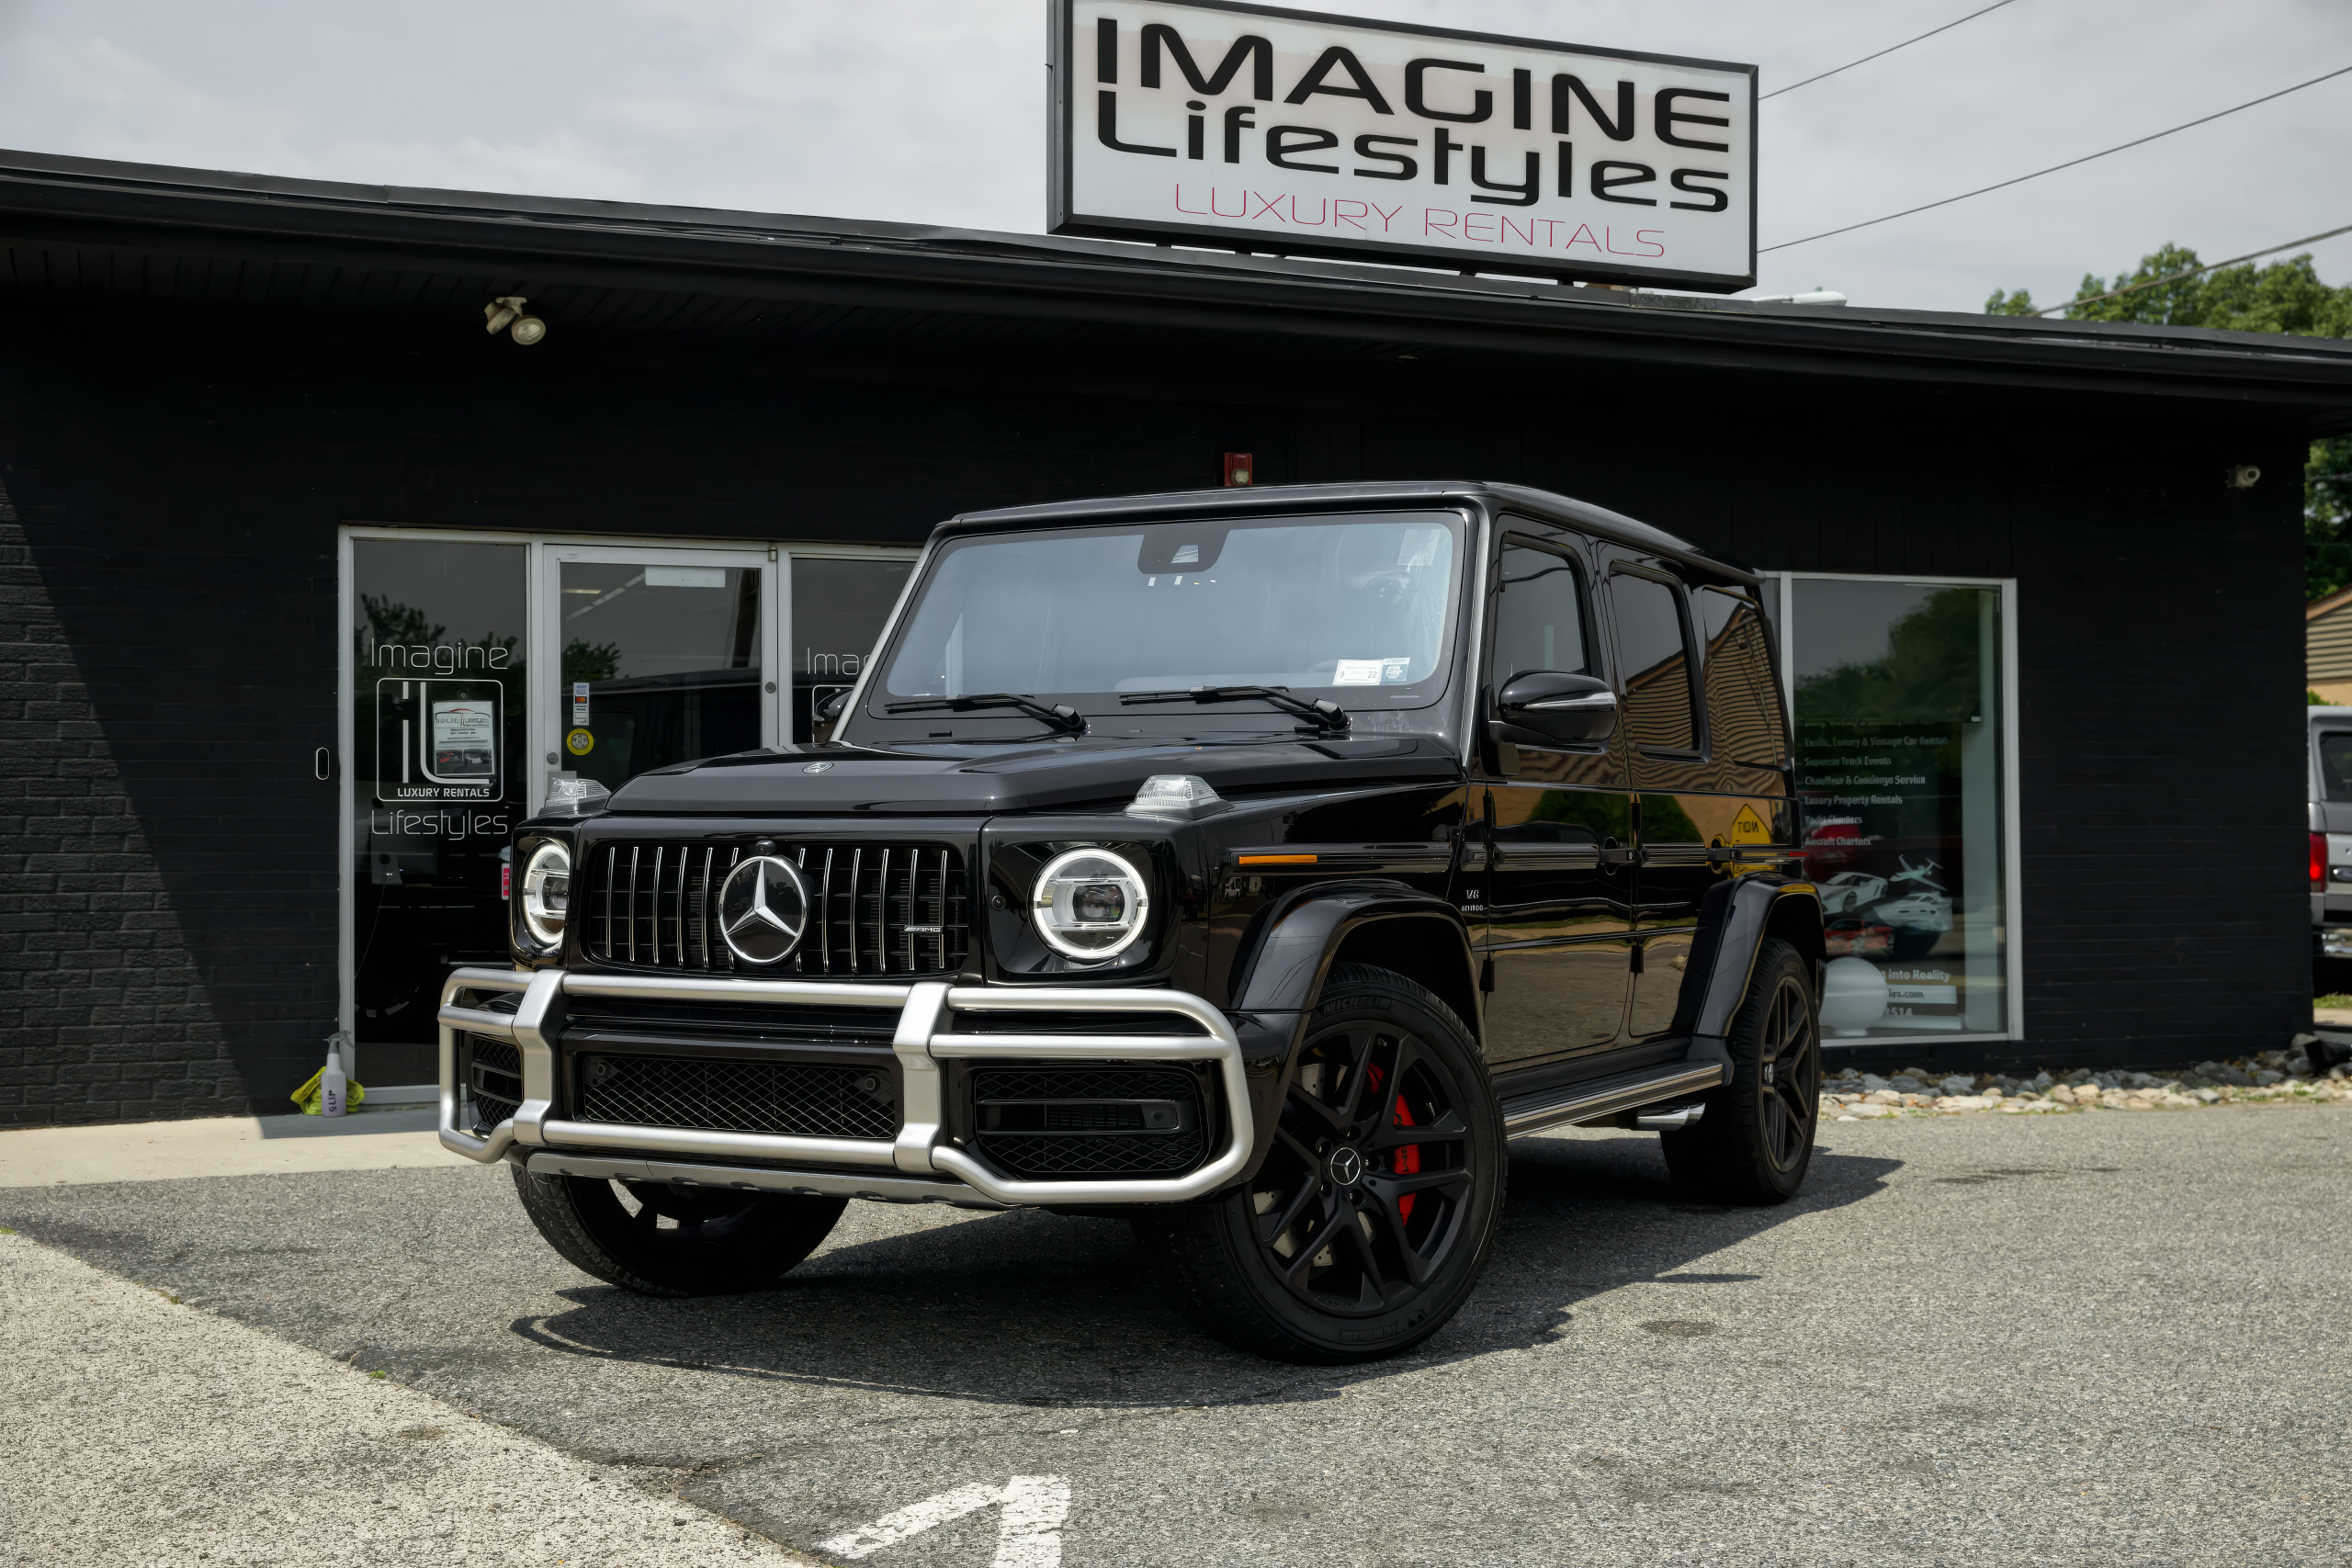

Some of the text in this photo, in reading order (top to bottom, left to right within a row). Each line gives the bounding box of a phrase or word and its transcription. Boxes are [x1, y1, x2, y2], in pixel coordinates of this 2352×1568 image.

[1097, 17, 1730, 153] IMAGINE
[1097, 89, 1730, 213] Lifestyles
[1175, 183, 1665, 258] LUXURY RENTALS
[371, 637, 509, 675] Imagine
[397, 787, 490, 798] LUXURY RENTALS
[371, 809, 508, 840] Lifestyles
